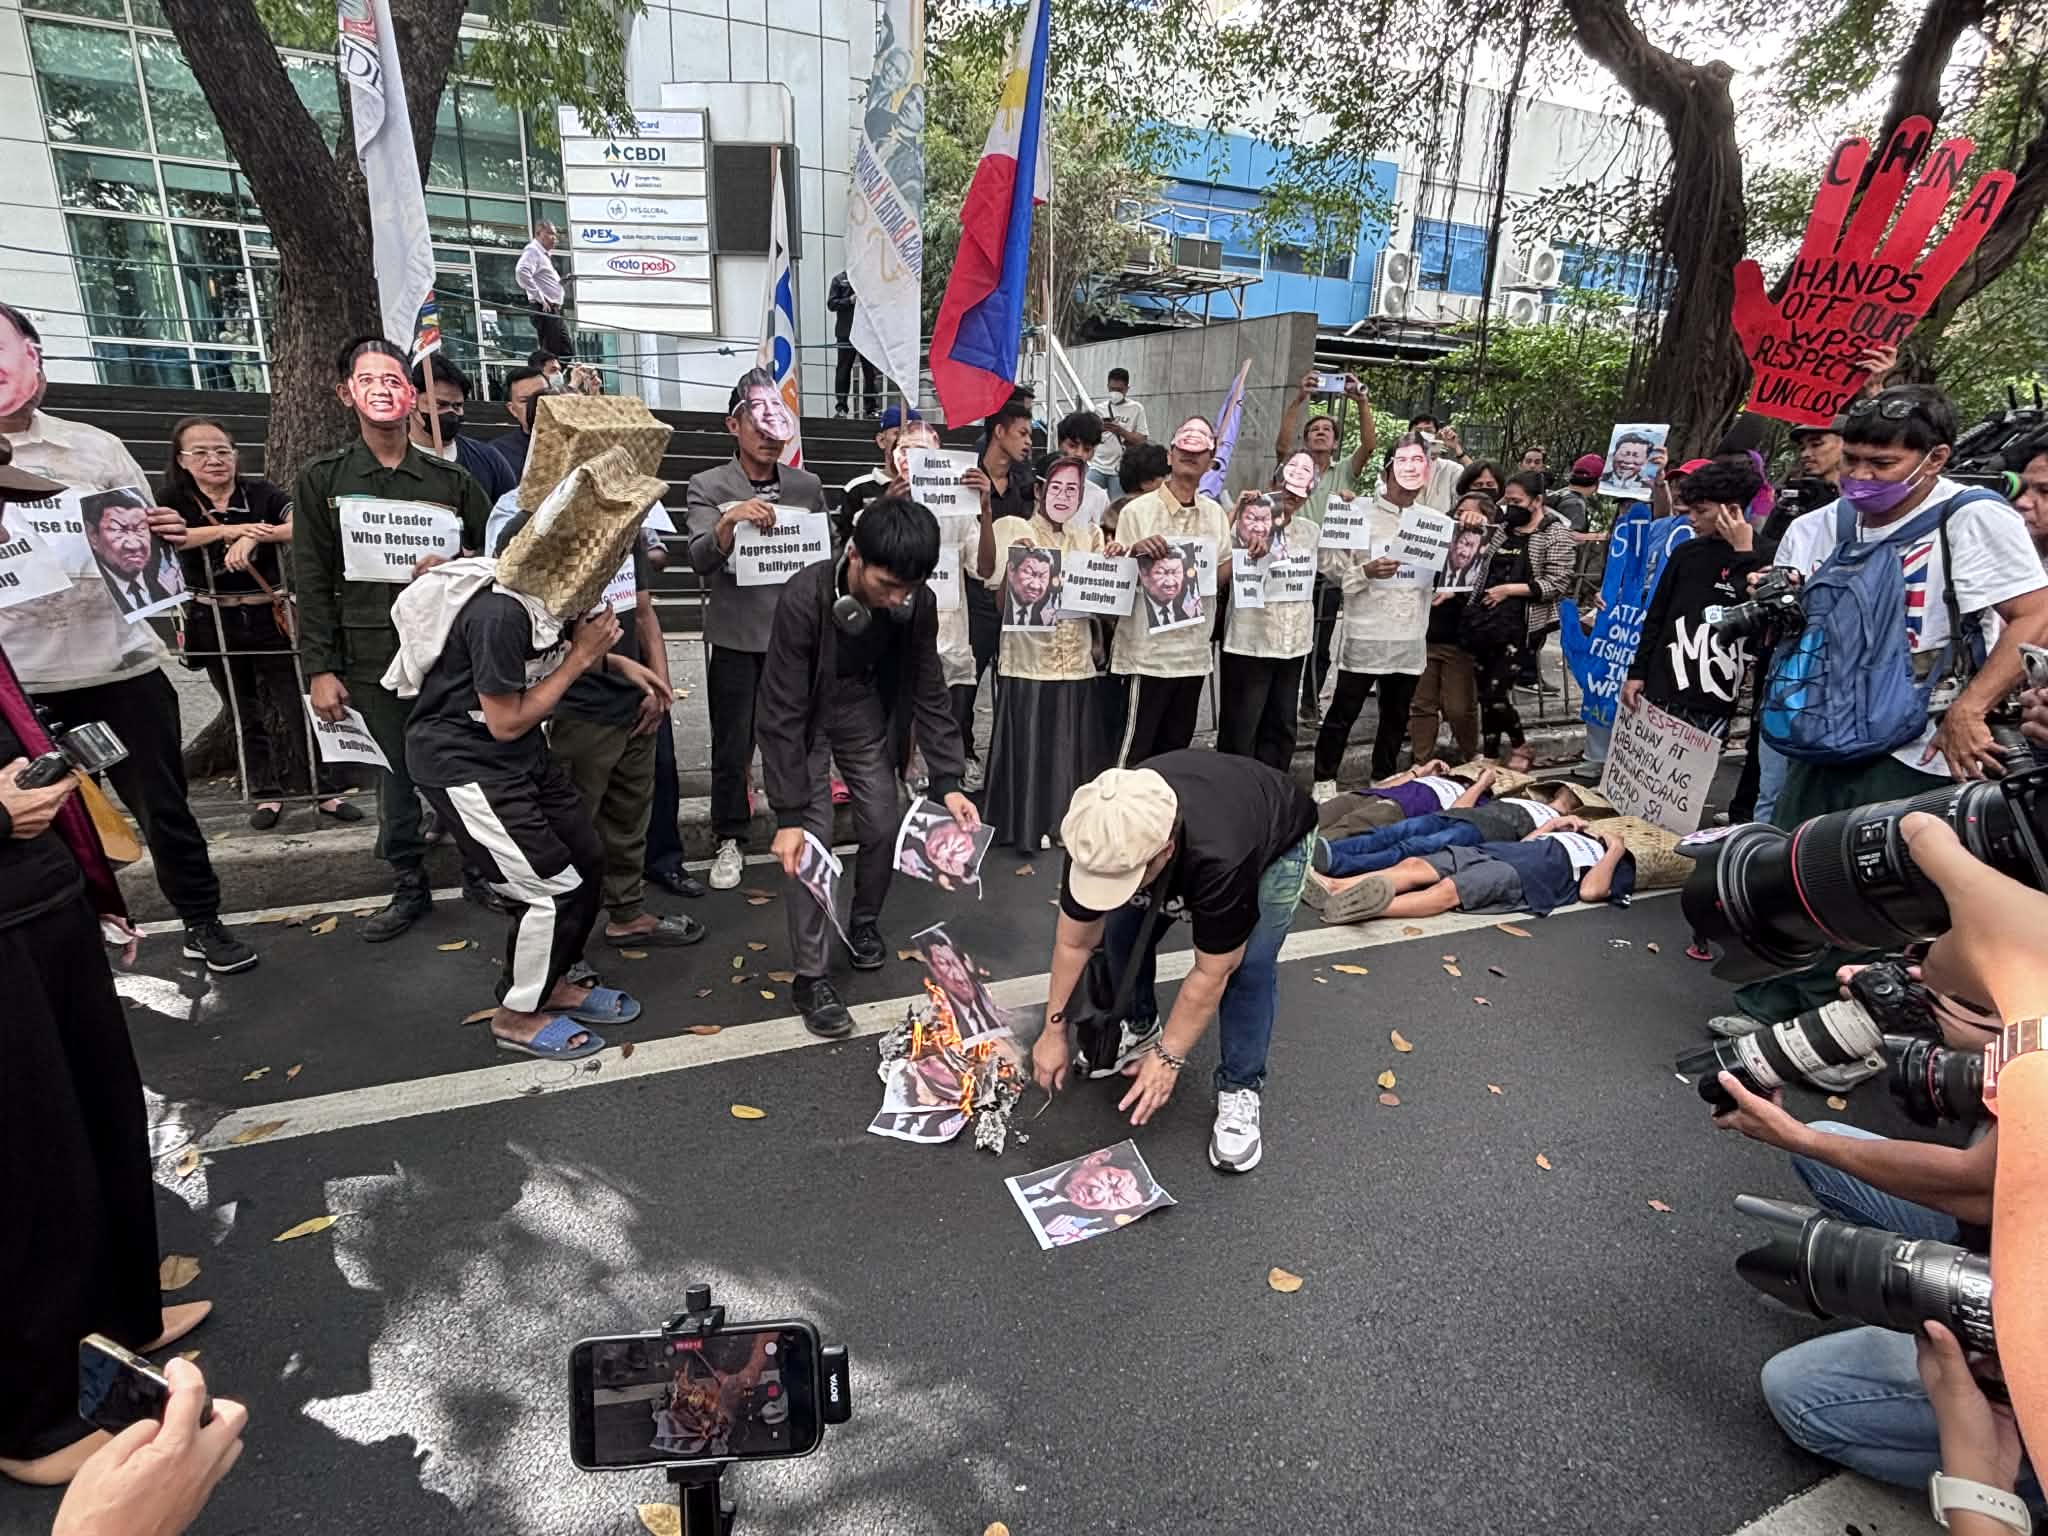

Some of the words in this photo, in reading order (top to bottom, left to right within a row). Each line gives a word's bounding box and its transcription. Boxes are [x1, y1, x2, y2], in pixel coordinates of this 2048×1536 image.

[623, 146, 666, 161] CBDI
[582, 229, 613, 239] APEX
[610, 259, 640, 270] moto
[641, 258, 670, 275] posh
[1793, 257, 1924, 304] HANDS
[1782, 293, 1854, 323] OFF
[1850, 302, 1918, 343] OUR
[1752, 335, 1872, 387] RESPECT
[1757, 373, 1848, 418] UNCLOS
[66, 520, 83, 534] to
[362, 511, 387, 524] Our
[388, 512, 433, 527] Leader
[351, 531, 382, 545] Who
[385, 532, 430, 546] Refuse
[433, 535, 446, 547] to
[760, 524, 801, 538] Against
[740, 543, 800, 557] Aggression
[802, 540, 822, 553] and
[384, 552, 417, 566] Yield
[1087, 559, 1118, 572] Against
[1067, 573, 1115, 588] Aggression
[1116, 579, 1131, 590] and
[1605, 662, 1629, 682] IN
[1668, 743, 1690, 761] AT
[1668, 767, 1692, 790] NG
[830, 1373, 839, 1403] BOYA
